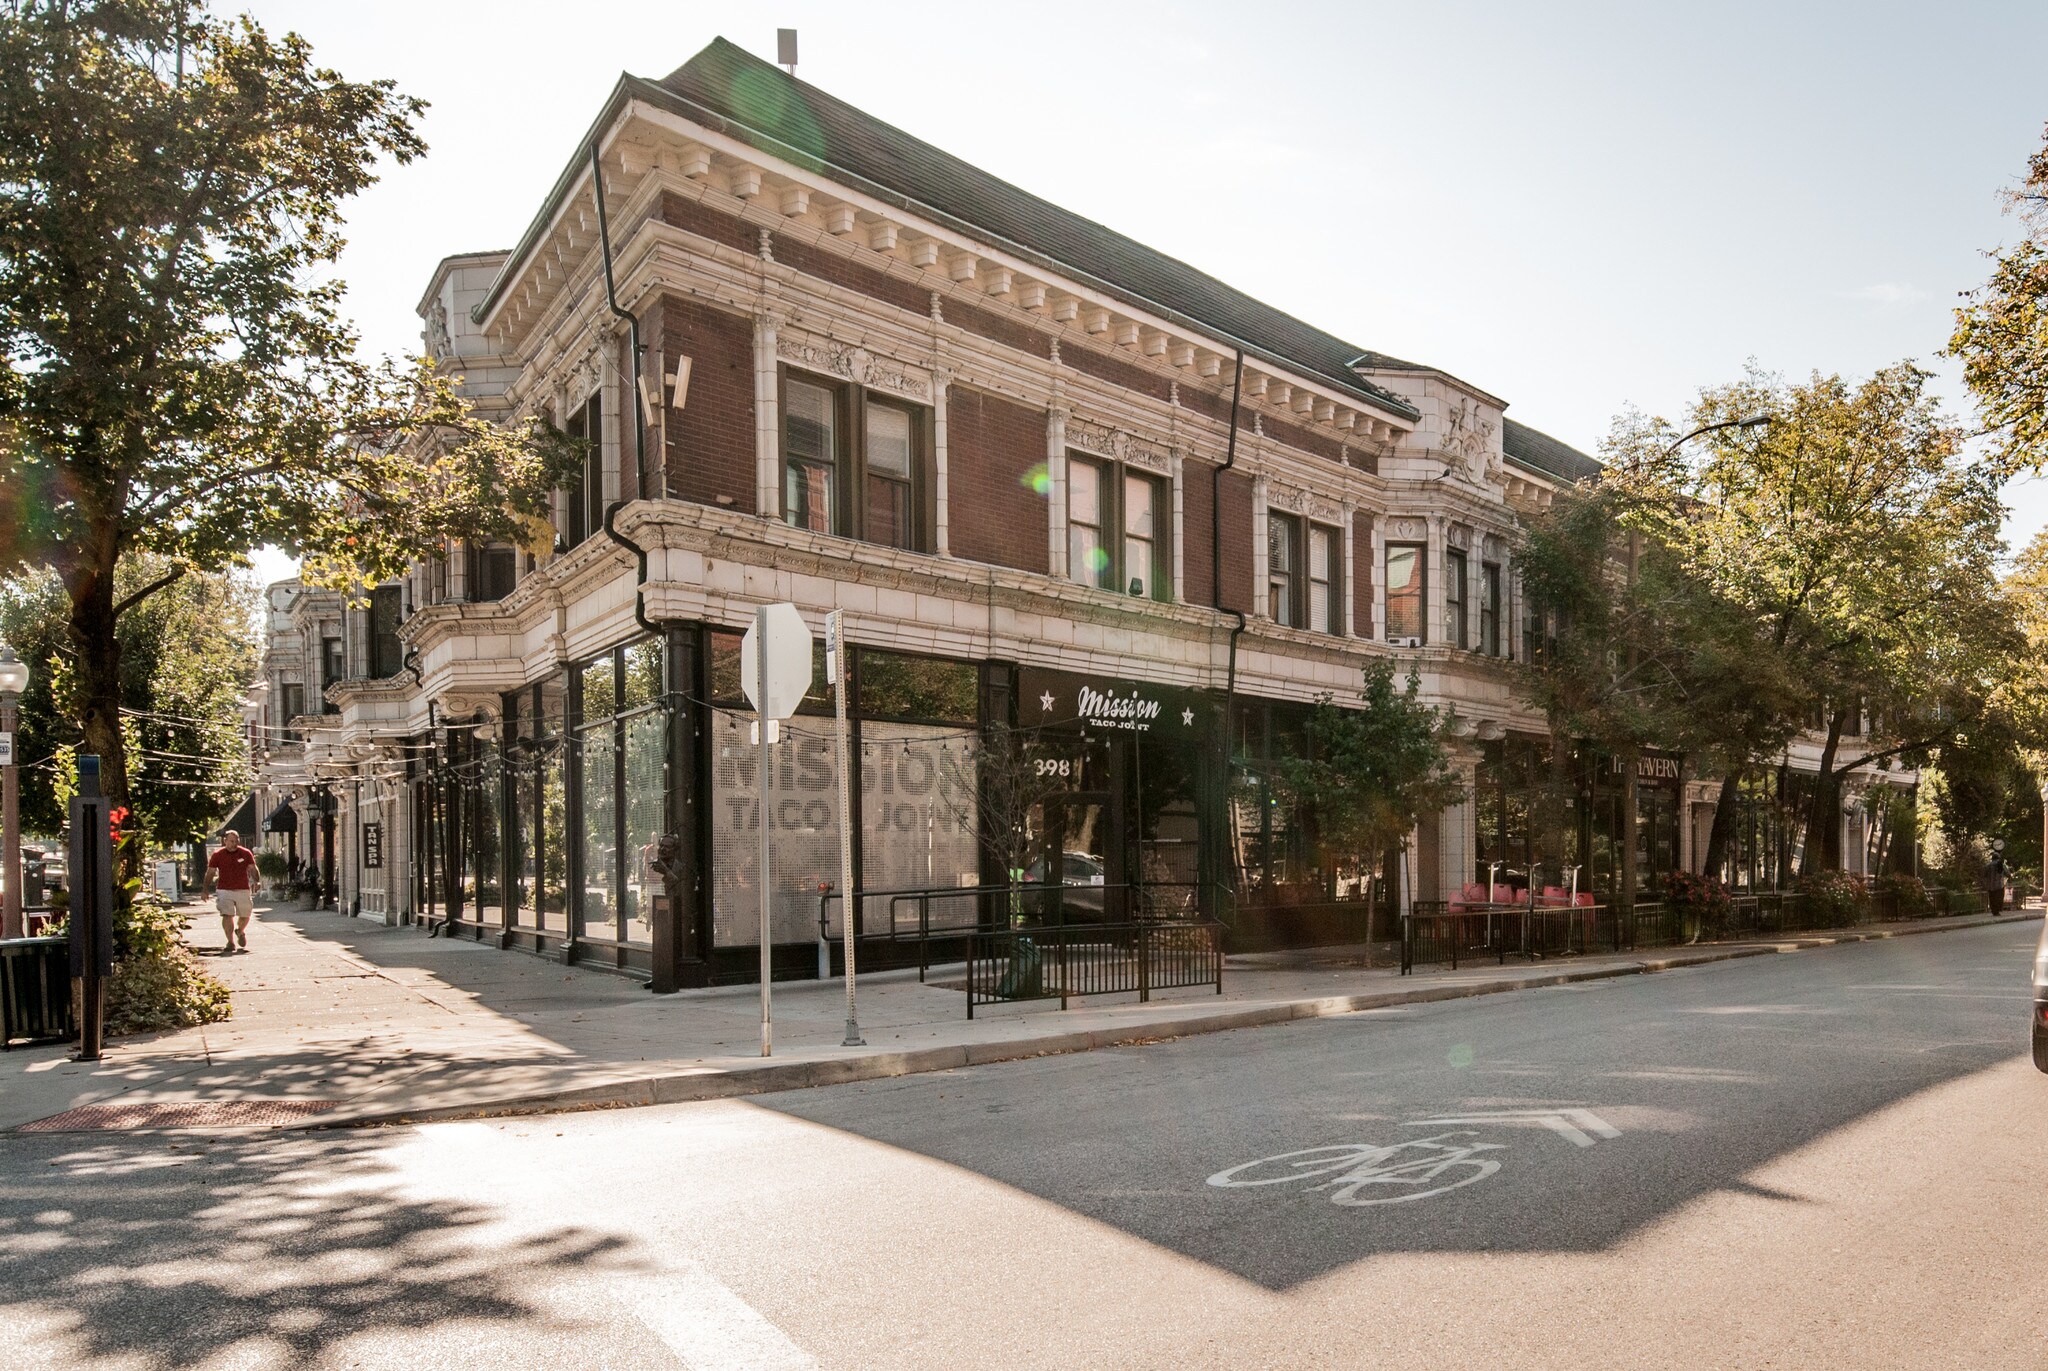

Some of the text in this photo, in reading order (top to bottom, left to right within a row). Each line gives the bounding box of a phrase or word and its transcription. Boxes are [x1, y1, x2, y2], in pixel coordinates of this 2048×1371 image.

[1078, 685, 1162, 719] Mission
[1089, 718, 1116, 729] TACO
[1033, 758, 1070, 777] 398
[725, 797, 832, 831] TACO
[367, 826, 378, 845] TAN
